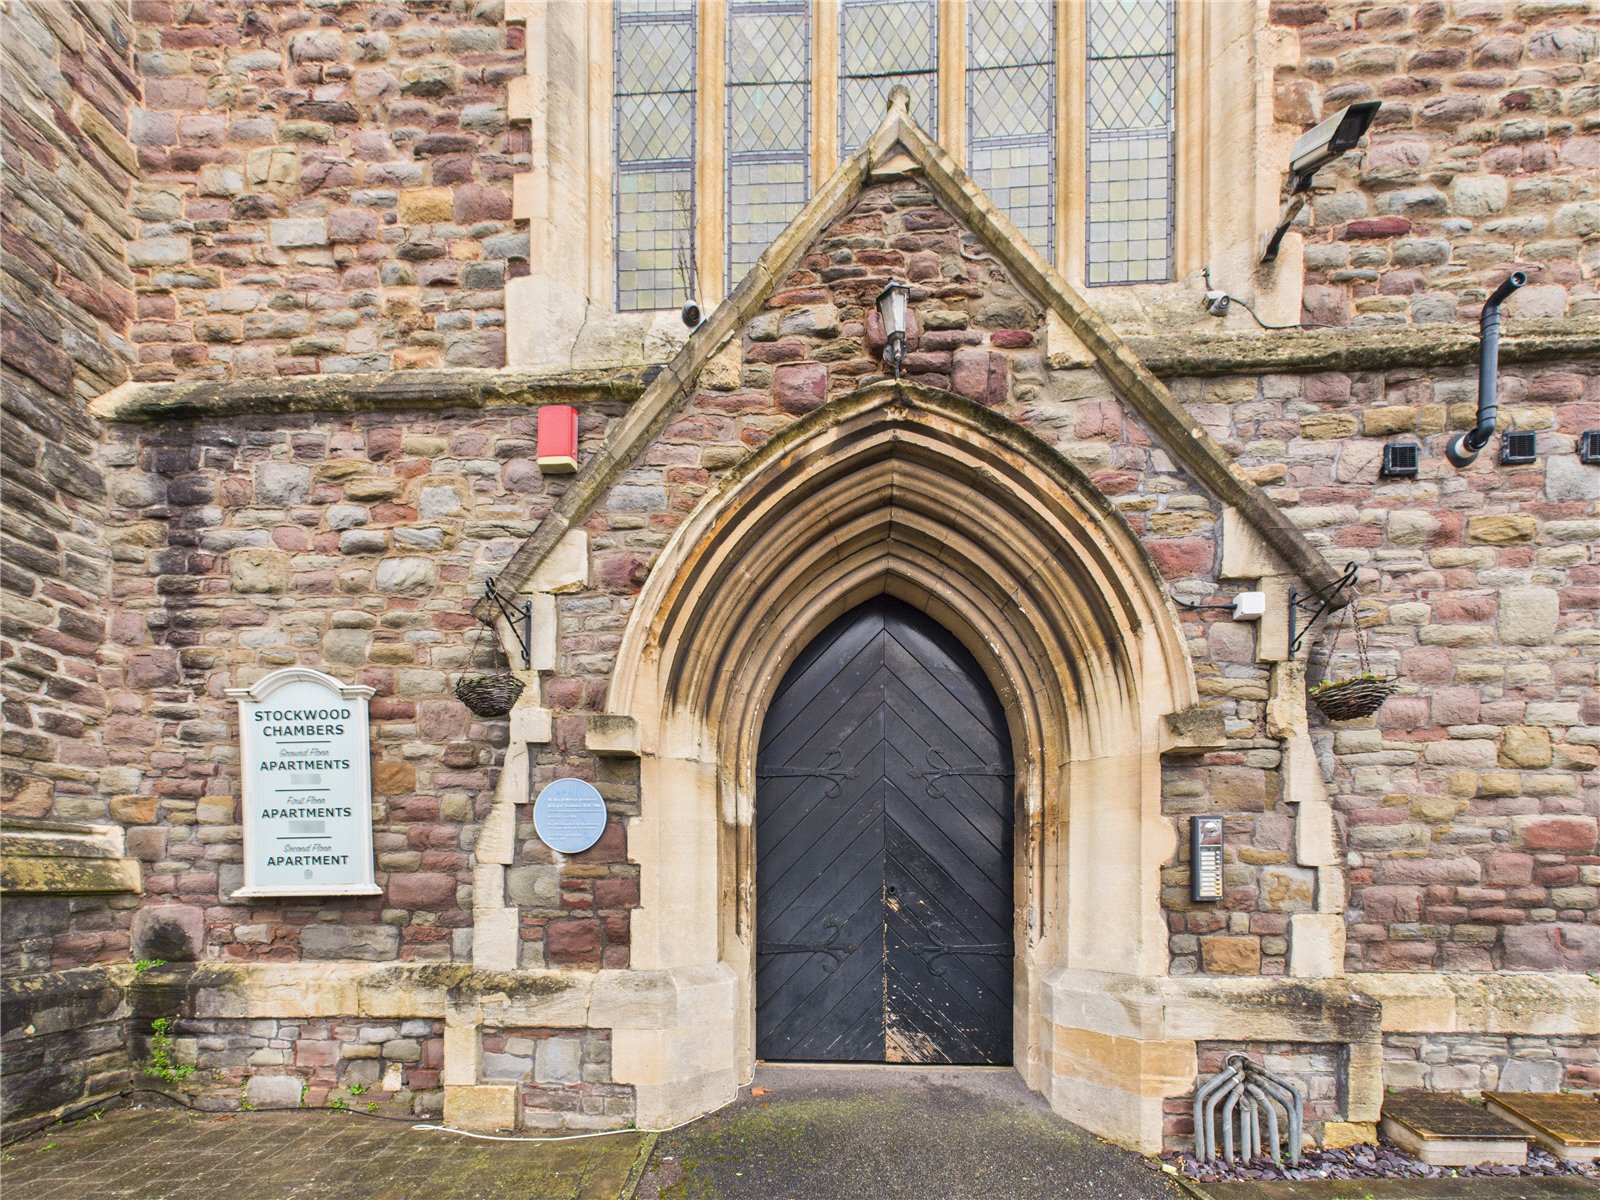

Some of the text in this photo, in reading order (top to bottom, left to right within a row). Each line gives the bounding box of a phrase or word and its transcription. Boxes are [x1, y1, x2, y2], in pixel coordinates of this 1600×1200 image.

[254, 708, 351, 722] STOCKWOOD
[262, 724, 344, 737] CHAMBERS
[279, 747, 330, 757] Ground Floor
[260, 759, 350, 771] APARTMENTS
[261, 807, 352, 819] APARTMENTS
[283, 843, 312, 853] Second
[267, 855, 349, 867] APARTMENT
